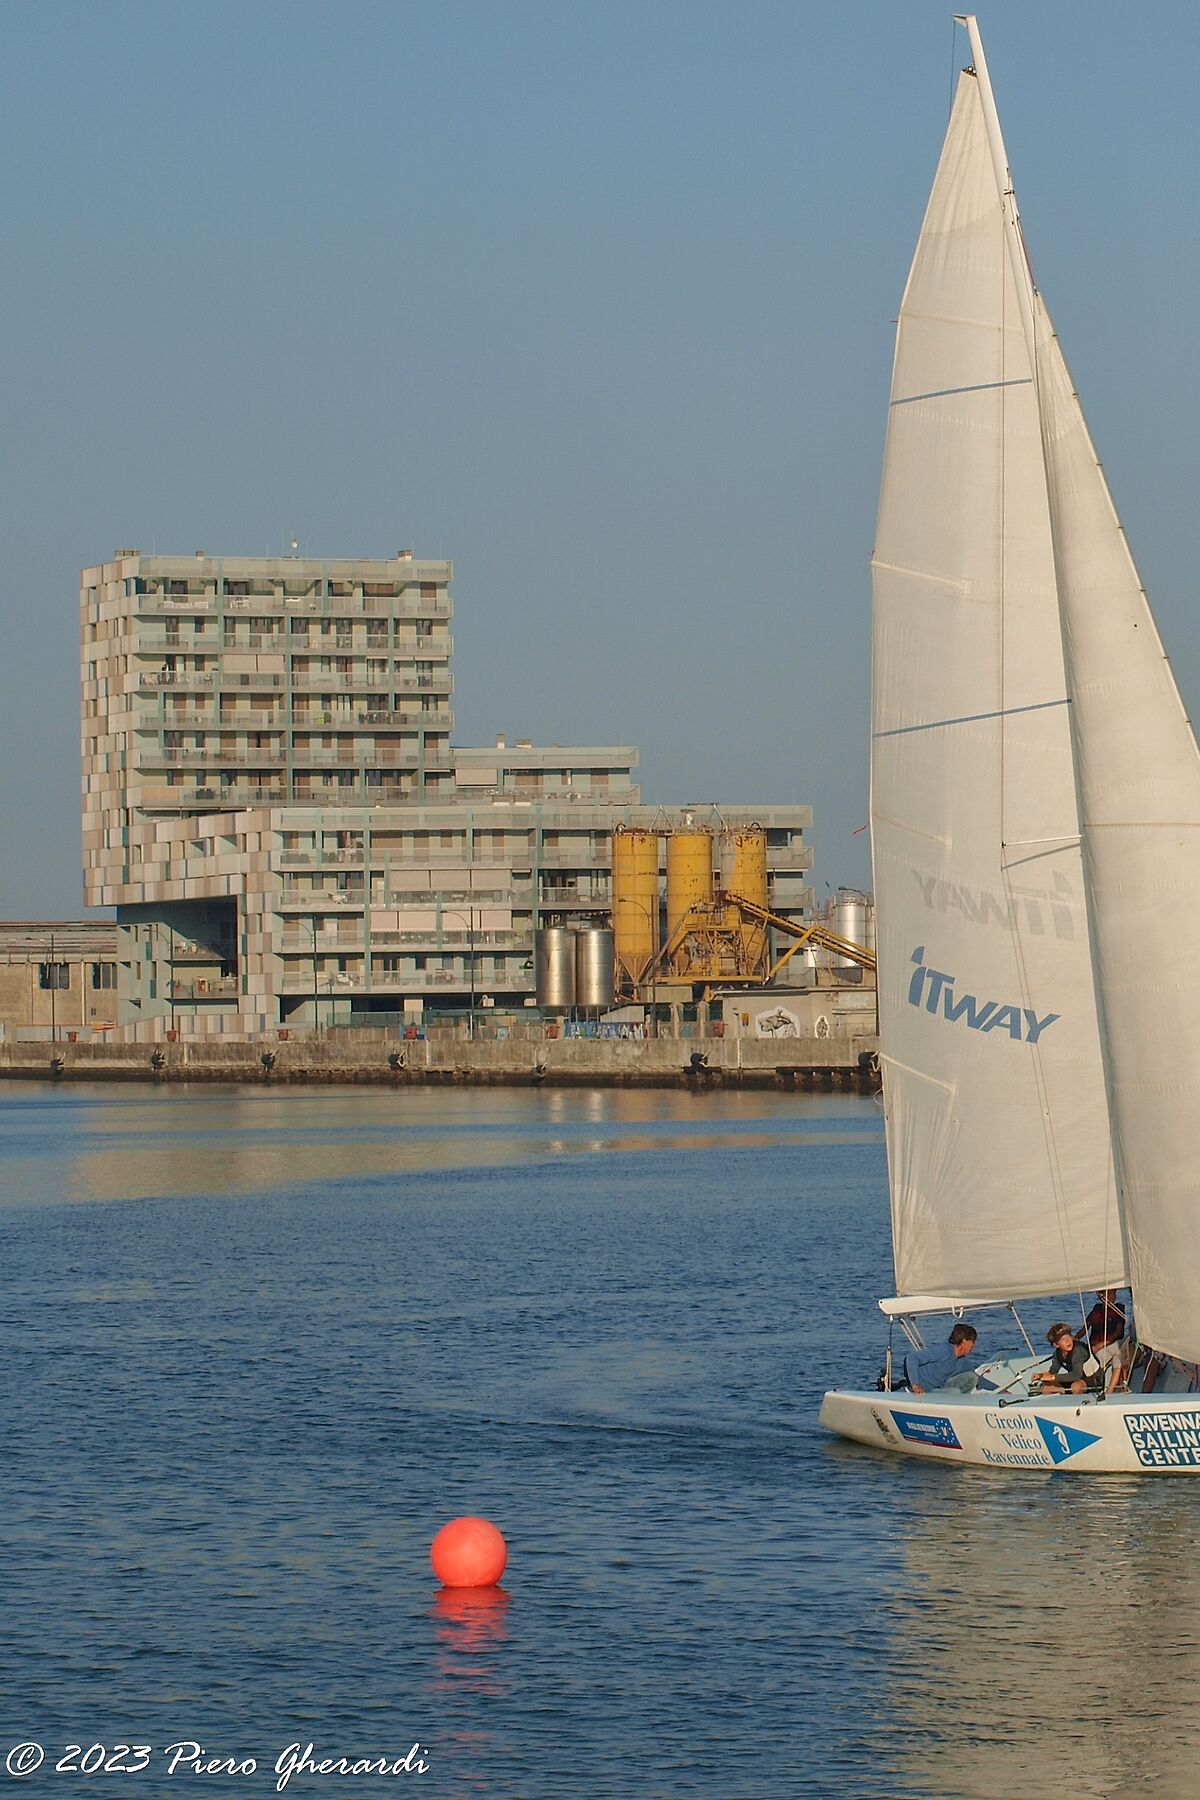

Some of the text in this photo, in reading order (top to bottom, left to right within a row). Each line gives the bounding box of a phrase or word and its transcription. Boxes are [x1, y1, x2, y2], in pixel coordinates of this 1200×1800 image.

[985, 1413, 1033, 1429] Circolo
[1001, 1433, 1042, 1449] Velico
[981, 1448, 1050, 1465] Ravennate
